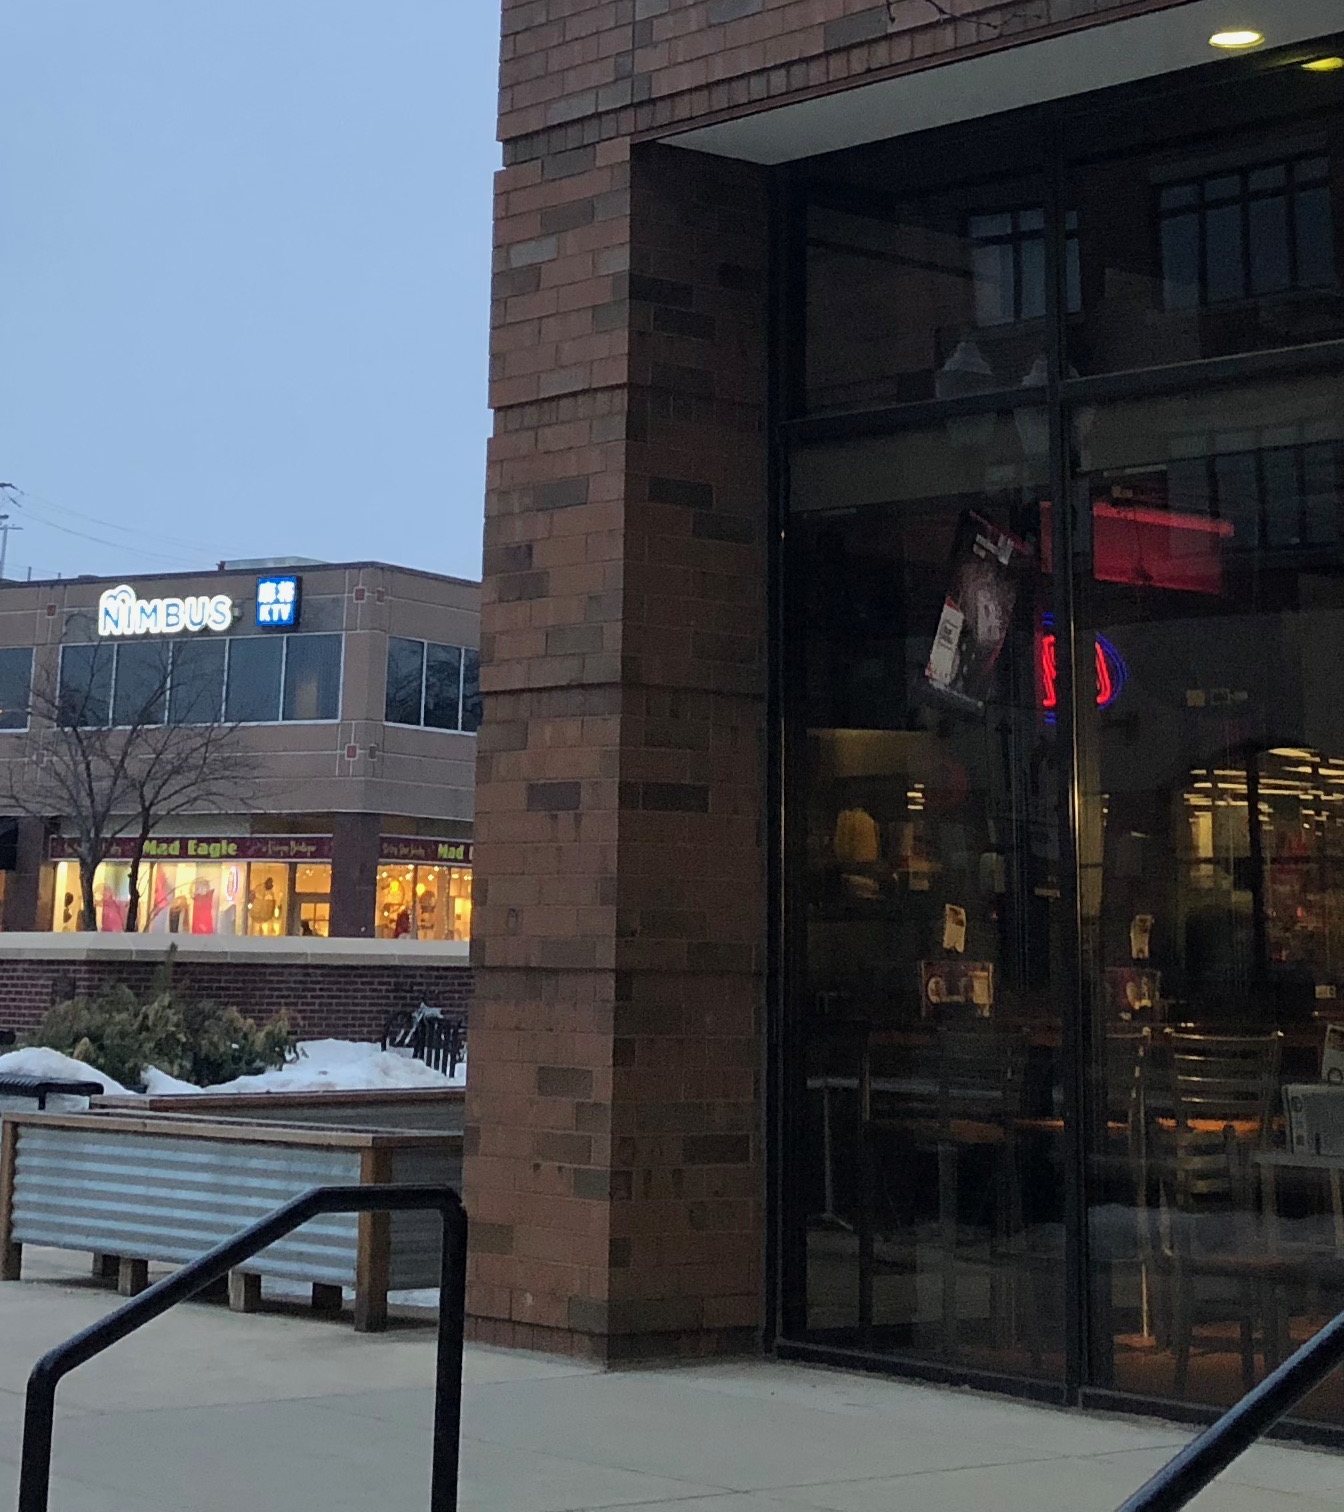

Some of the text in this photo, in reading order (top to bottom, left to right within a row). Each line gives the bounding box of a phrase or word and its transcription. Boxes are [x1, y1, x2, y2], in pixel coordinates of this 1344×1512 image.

[99, 586, 233, 636] NIMBUS
[259, 603, 292, 621] KTV
[142, 839, 180, 855] Mad
[187, 839, 239, 859] Eagle
[437, 843, 465, 860] Mad
